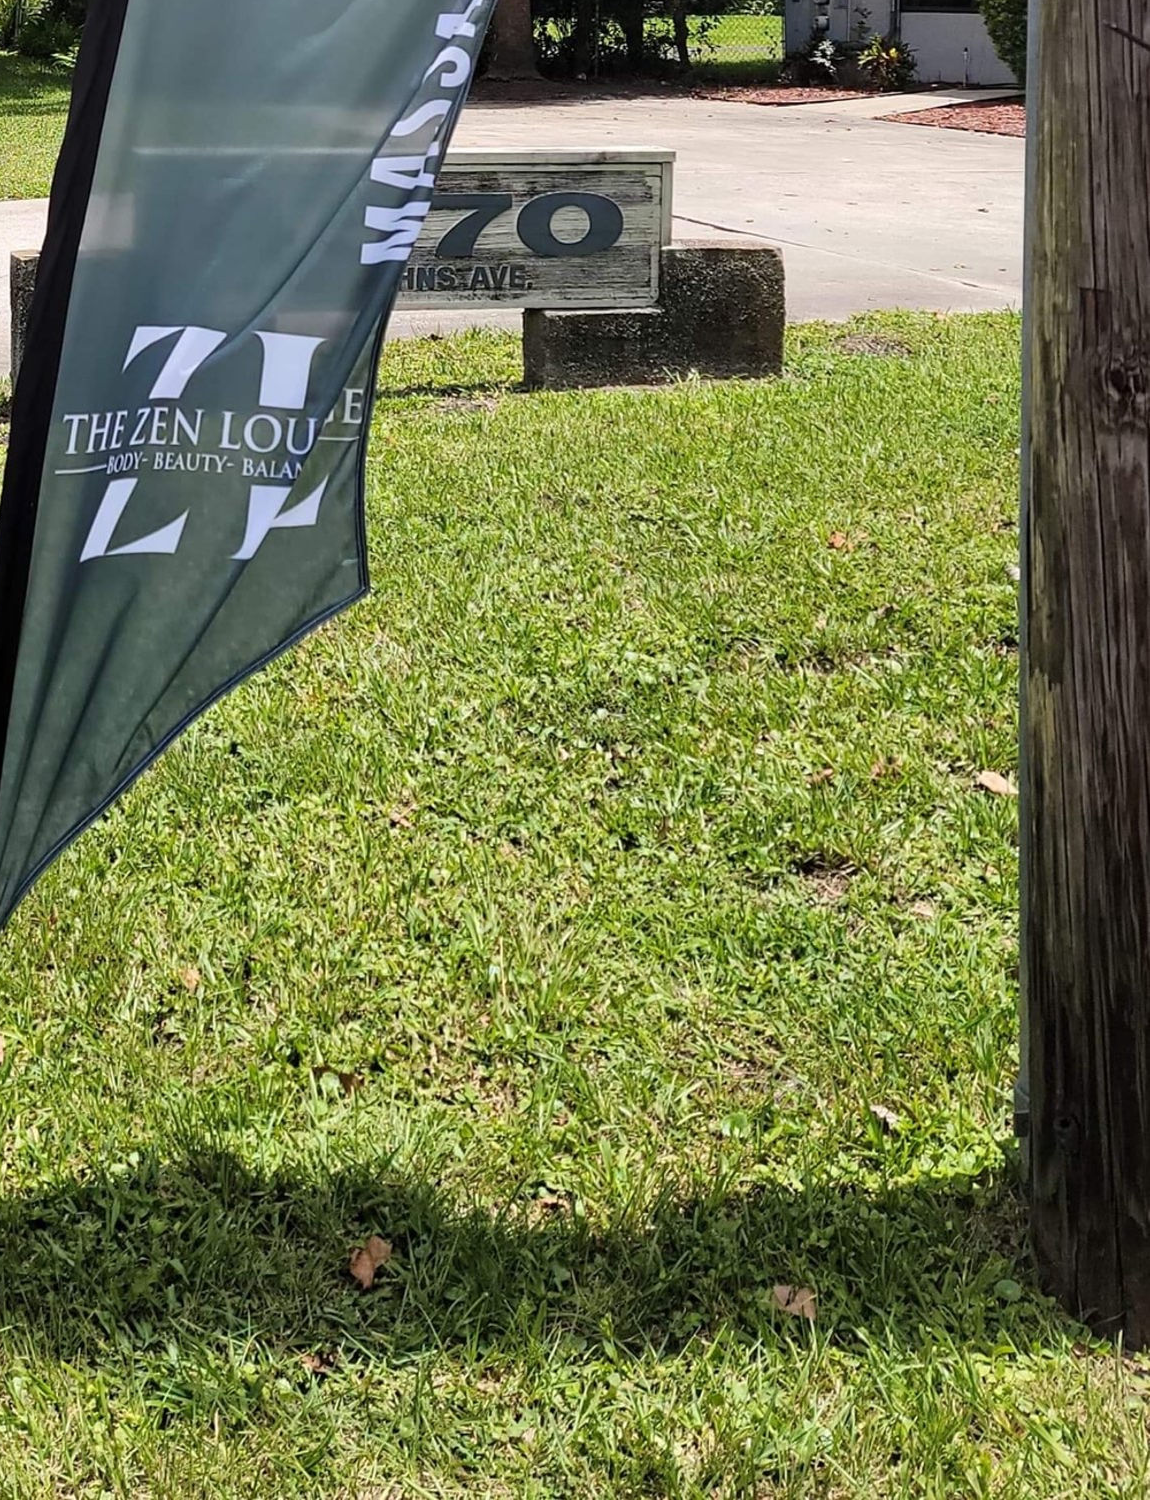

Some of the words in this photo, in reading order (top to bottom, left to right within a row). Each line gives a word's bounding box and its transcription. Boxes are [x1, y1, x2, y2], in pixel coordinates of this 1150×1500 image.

[431, 191, 624, 259] 70
[402, 265, 457, 291] HNS
[470, 264, 534, 290] AVE.
[63, 409, 128, 456] THE
[129, 406, 203, 447] ZEN
[219, 388, 364, 456] LOUE
